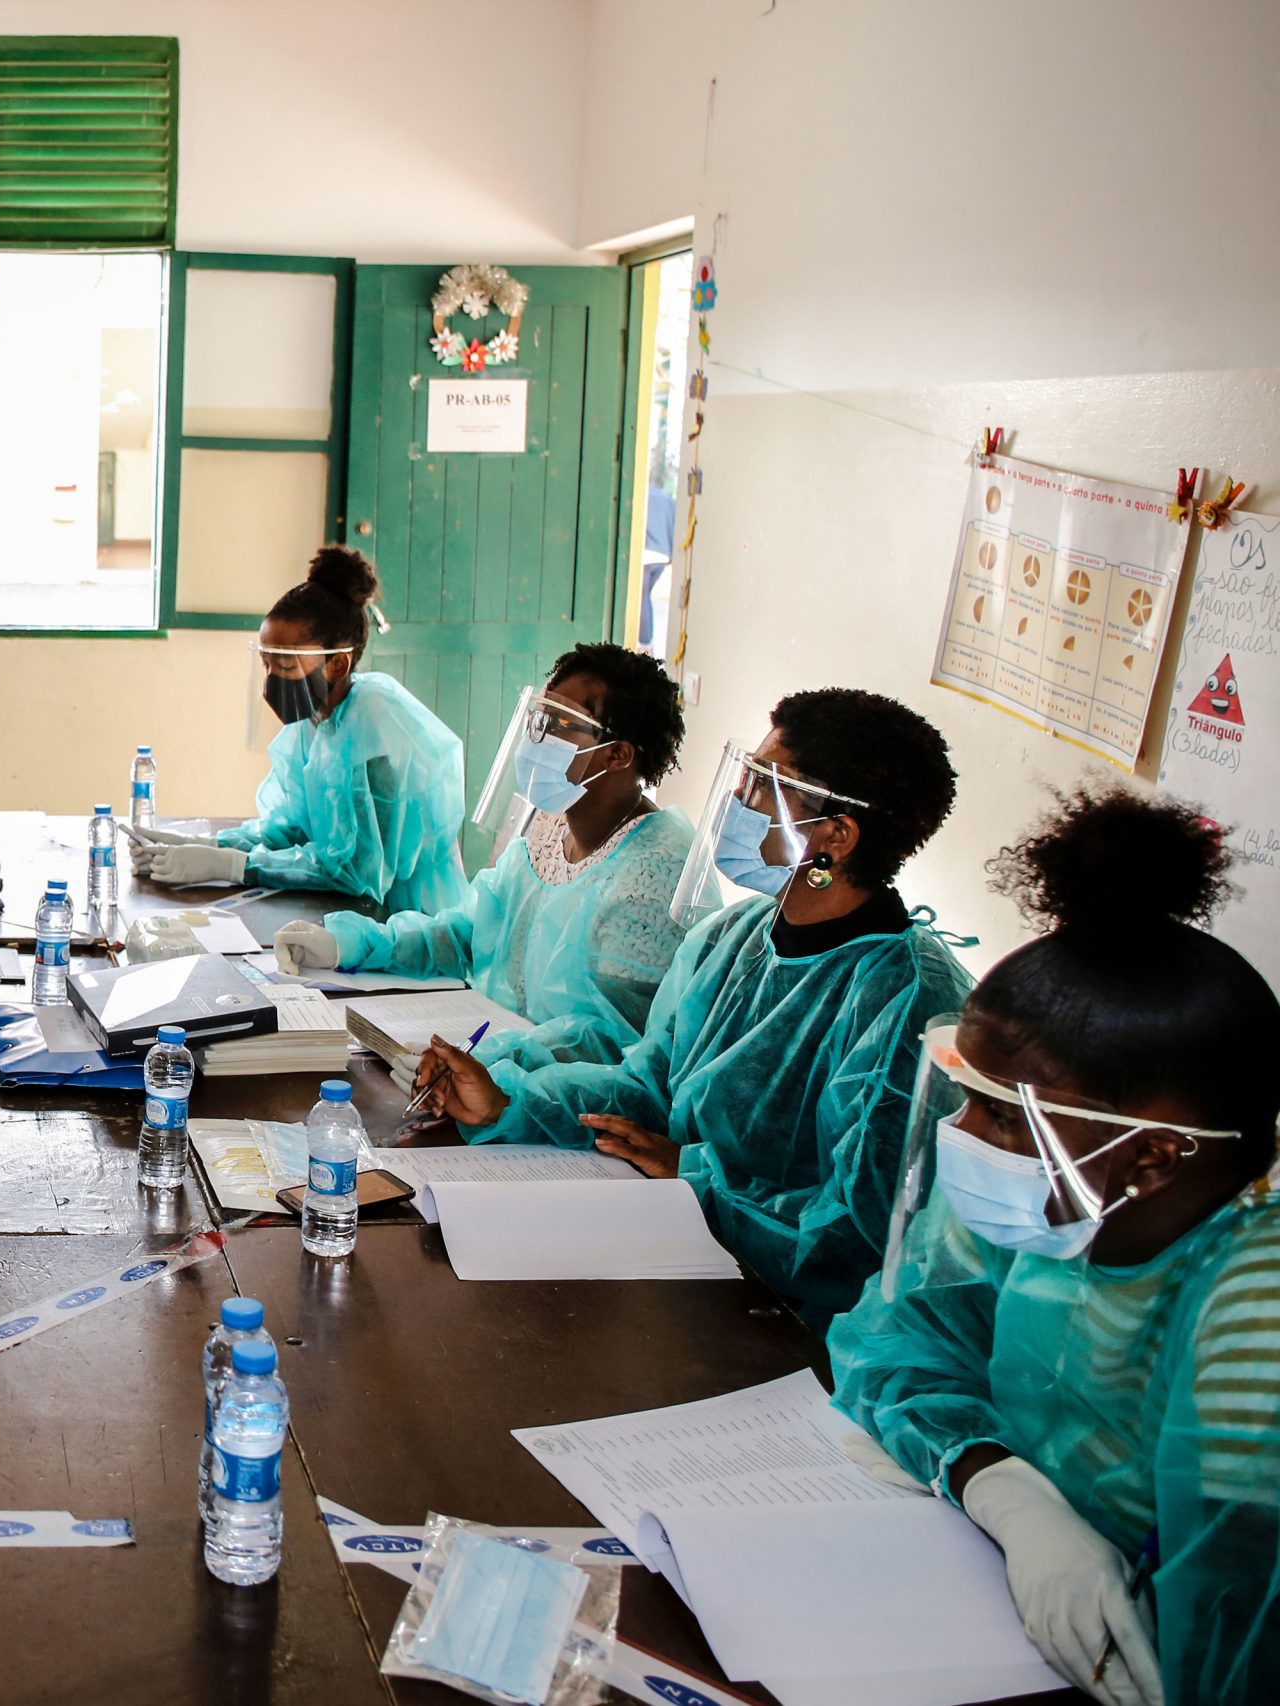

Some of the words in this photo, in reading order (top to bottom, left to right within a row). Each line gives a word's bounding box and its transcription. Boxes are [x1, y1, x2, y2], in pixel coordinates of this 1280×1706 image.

[446, 394, 511, 406] PR-AB-05
[1033, 477, 1051, 490] parte
[1090, 493, 1114, 505] parte
[1125, 499, 1132, 508] a
[1134, 500, 1163, 515] quinta
[1188, 715, 1243, 743] Triângulo
[90, 1523, 124, 1533] JN
[355, 1543, 419, 1551] MTCV
